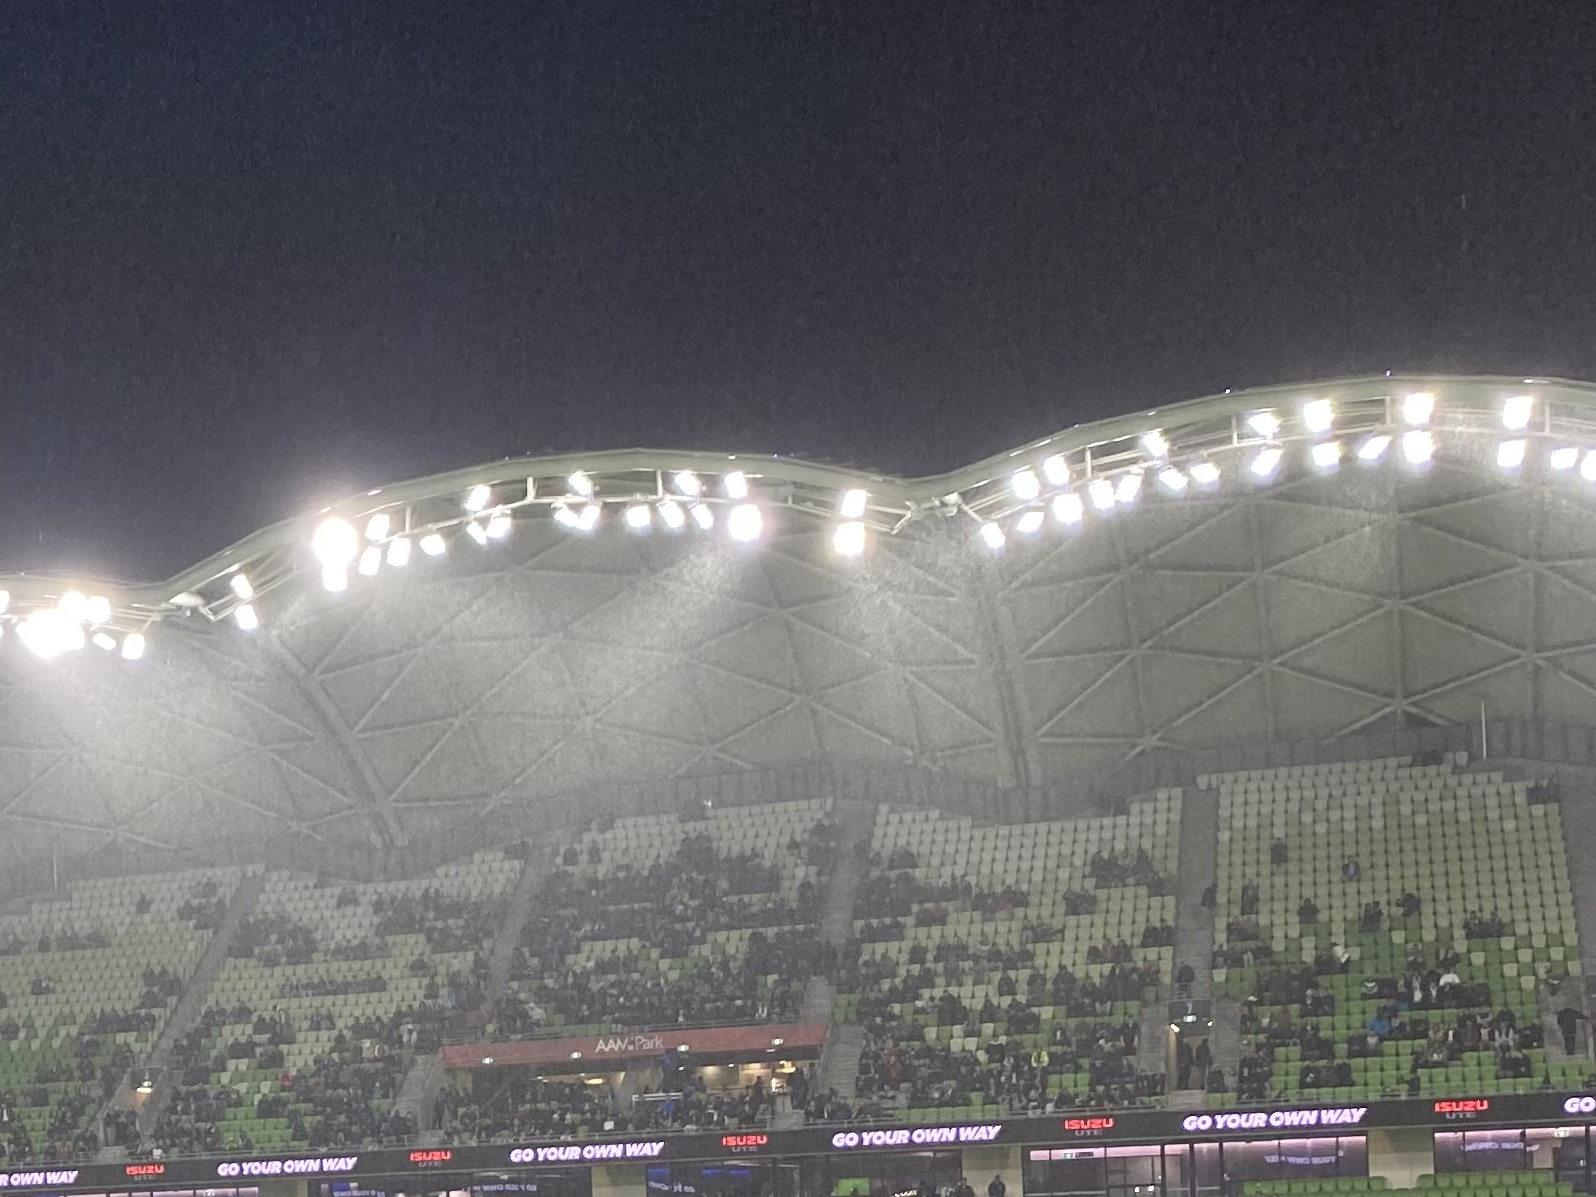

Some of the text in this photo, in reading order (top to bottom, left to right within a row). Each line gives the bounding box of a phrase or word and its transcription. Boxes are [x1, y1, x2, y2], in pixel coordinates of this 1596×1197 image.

[634, 1034, 664, 1051] Park
[1435, 1100, 1489, 1112] ISUZU
[1564, 1097, 1596, 1113] GO
[1064, 1118, 1115, 1130] ISUZU
[1183, 1107, 1367, 1131] GO YOUR OWN WAY
[722, 1135, 768, 1147] ISUZU
[832, 1125, 1002, 1148] GO YOUR OWN WAY
[410, 1150, 452, 1162] ISUZU
[510, 1141, 665, 1162] GO YOUR OWN WAY
[126, 1164, 164, 1176] ISUZU
[217, 1156, 357, 1177] GO YOUR OWN WAY
[10, 1172, 45, 1186] OWN
[46, 1170, 79, 1185] WAY
